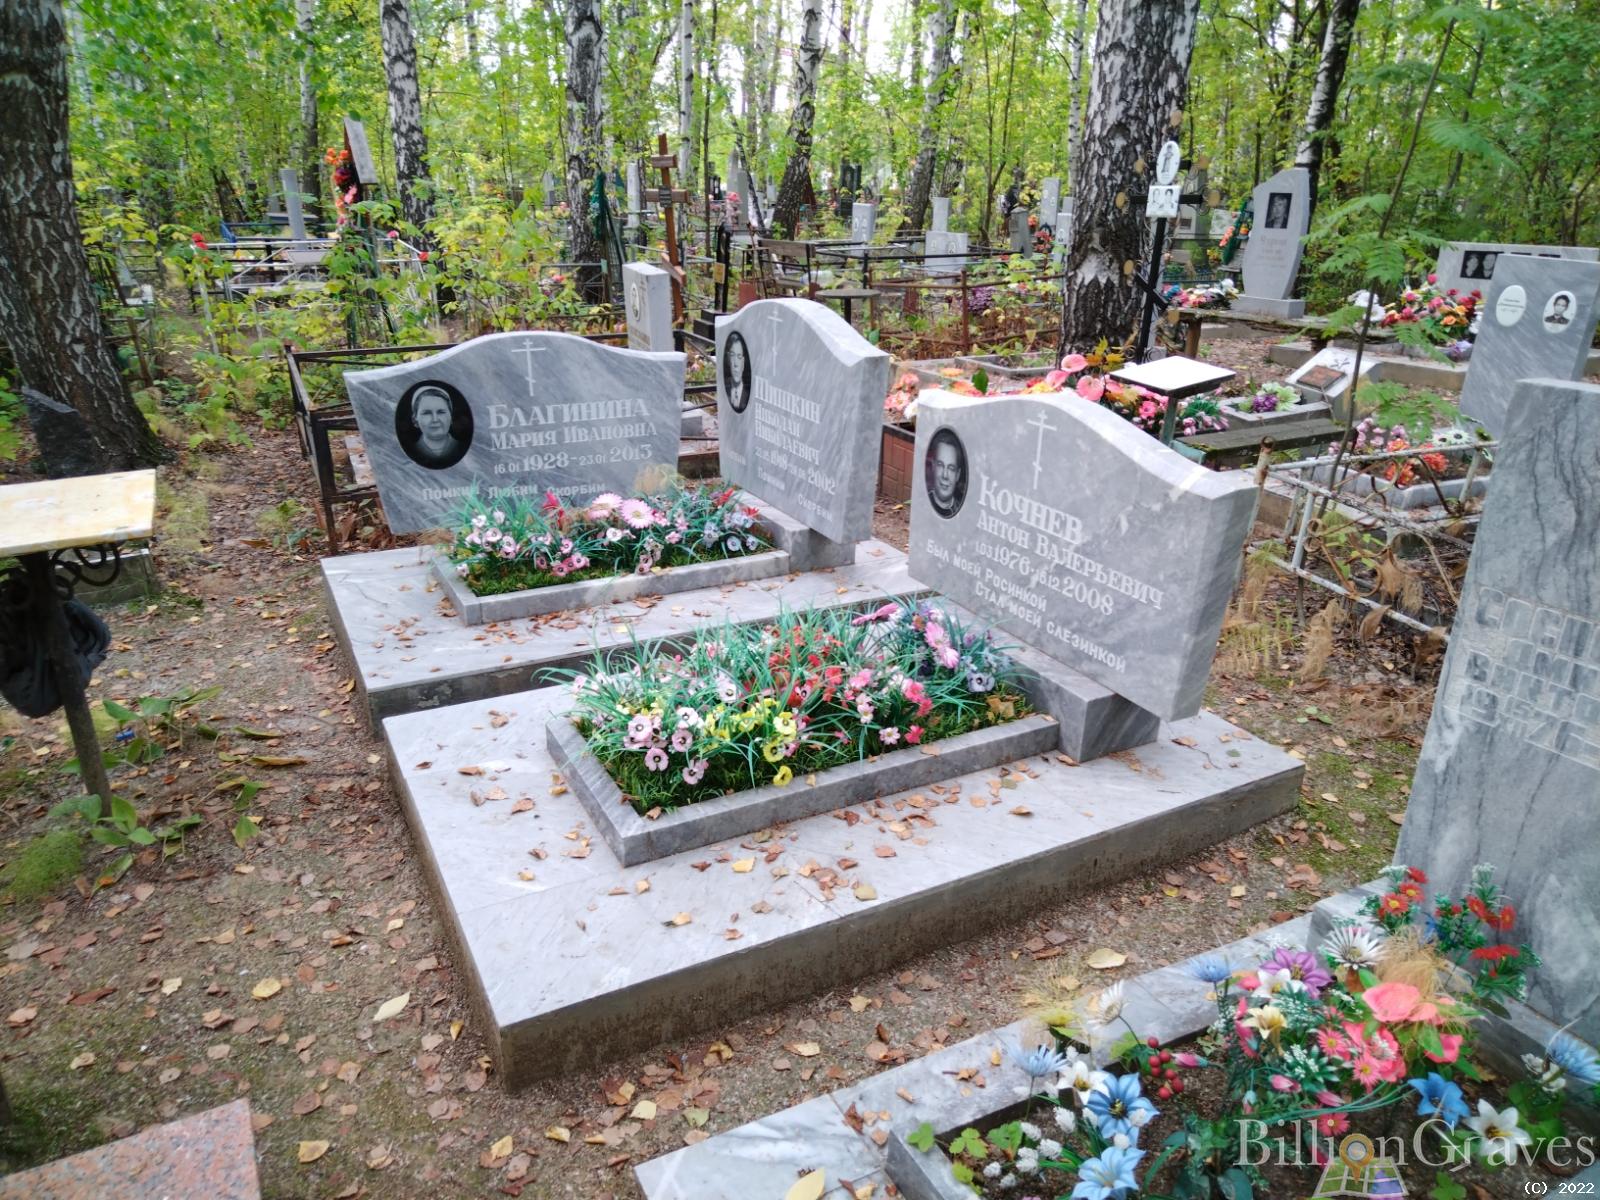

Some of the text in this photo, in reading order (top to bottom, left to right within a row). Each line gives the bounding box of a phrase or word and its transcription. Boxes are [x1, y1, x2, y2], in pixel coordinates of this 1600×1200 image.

[487, 399, 650, 428] БЛАГИНИНА
[490, 422, 657, 450] МАРИЯ ИВАНОВНА
[978, 474, 1083, 545] КОЧНЕВ
[927, 539, 949, 562] БЫЛ
[953, 554, 981, 578] МОЕЙ
[976, 509, 1164, 610] АНТОН ВАЛЕРЬЕВИЧ
[1046, 621, 1126, 673] СЛЕЗИНКОЙ
